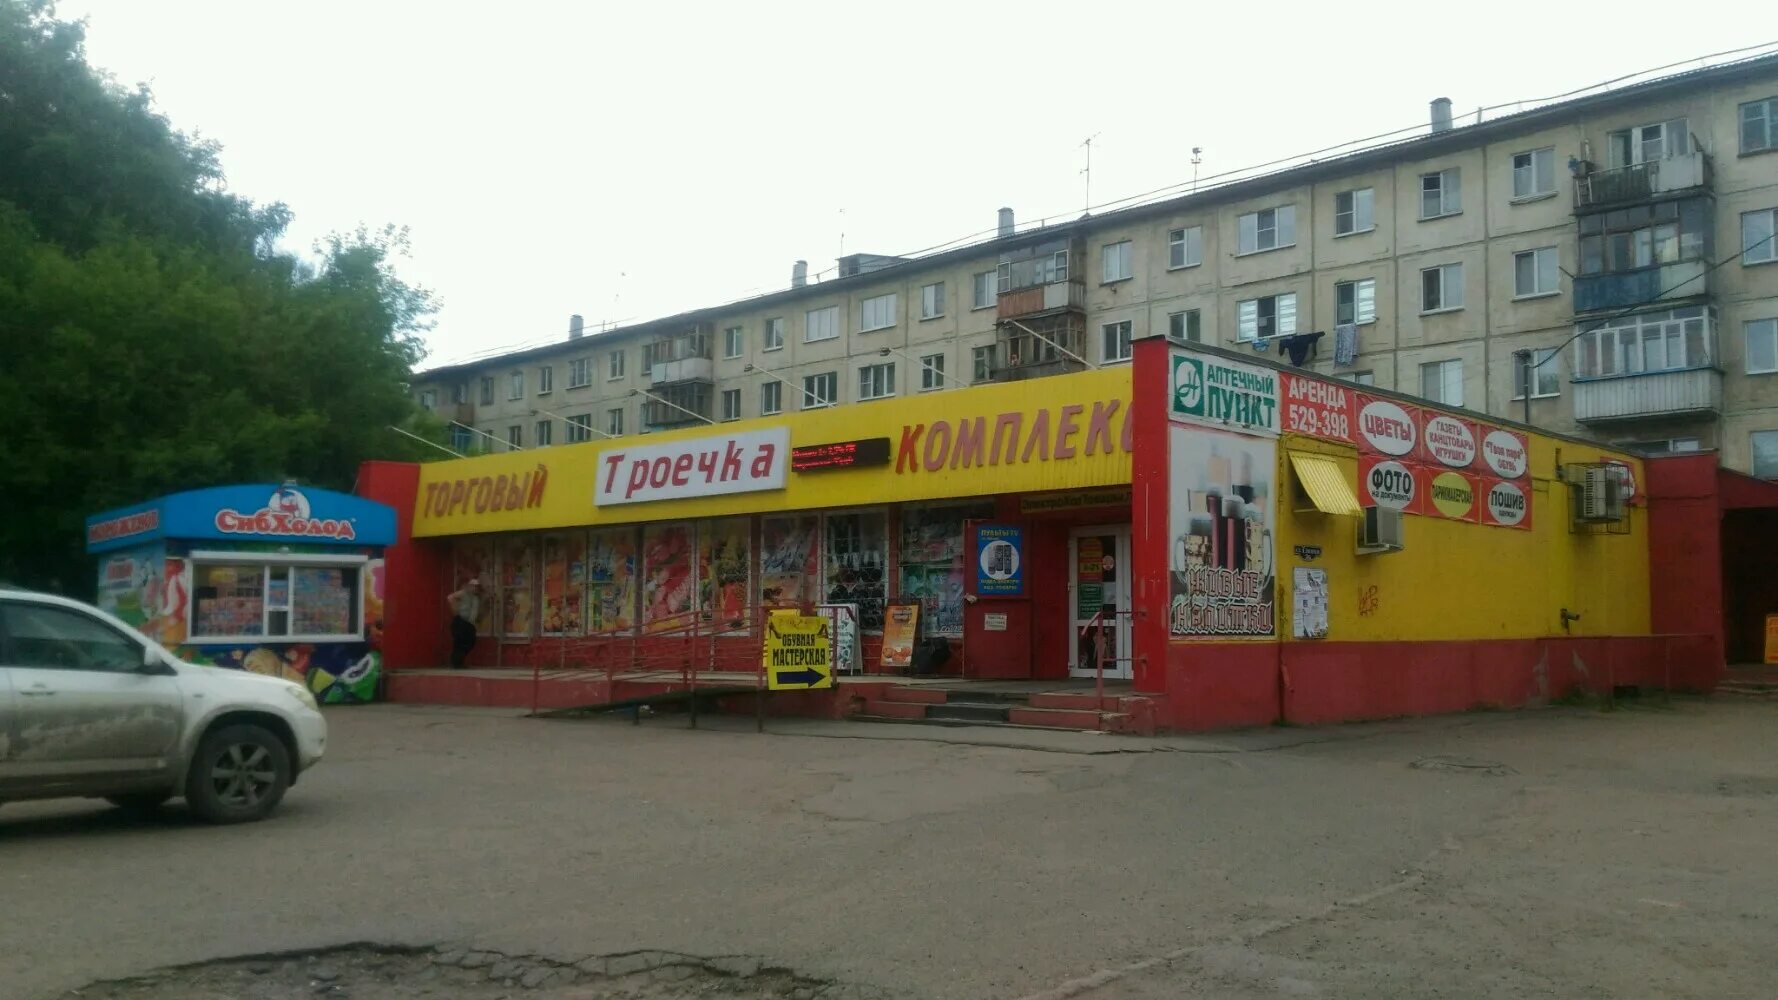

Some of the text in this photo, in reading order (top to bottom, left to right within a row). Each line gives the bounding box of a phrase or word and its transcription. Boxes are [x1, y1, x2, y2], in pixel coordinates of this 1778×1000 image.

[1207, 364, 1274, 395] АПТЕЧНЫЙ
[1288, 376, 1347, 410] АРЕНДА
[1208, 385, 1275, 428] ПУНКТ
[1289, 404, 1349, 438] 529-398
[1365, 413, 1412, 442] ЦВЕТЫ
[1436, 421, 1462, 437] ГАЗЕТЫ
[1429, 432, 1474, 451] КАНЦТОВАРЫ
[1435, 446, 1466, 461] ИГРУШКИ
[604, 440, 775, 499] Троечка
[1372, 468, 1411, 494] ФОТО
[423, 463, 548, 518] ТОРГОВЫЙ
[1491, 490, 1524, 510] ПОШИВ
[782, 634, 815, 647] ОБУВНАЯ
[772, 648, 826, 666] МАСТЕРСКАЯ
